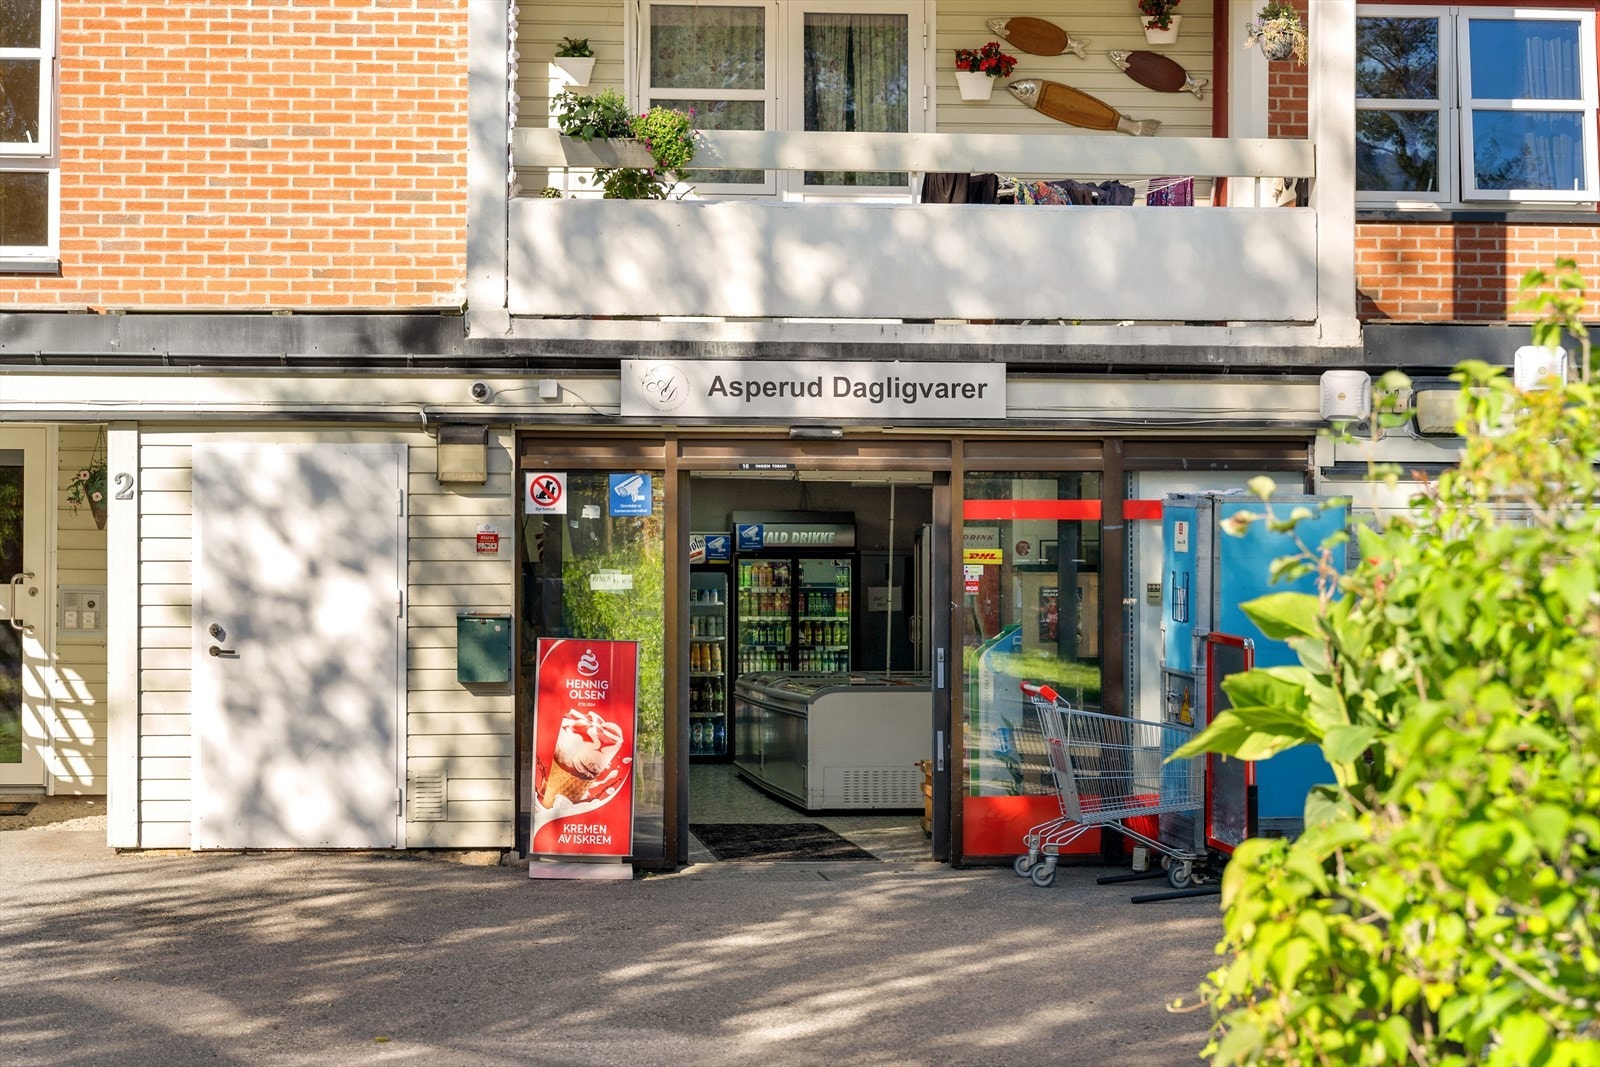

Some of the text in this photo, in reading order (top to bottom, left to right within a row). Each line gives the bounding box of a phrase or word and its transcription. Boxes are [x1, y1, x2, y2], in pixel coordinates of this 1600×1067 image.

[708, 375, 823, 402] Asperud
[833, 376, 988, 404] Dagligvarer
[114, 472, 135, 500] 2
[791, 531, 835, 544] DRIKKE
[968, 552, 997, 560] DHL
[565, 678, 609, 690] HENNIG
[568, 689, 606, 700] OLSEN
[563, 823, 607, 834] KREMEN
[557, 833, 612, 846] AV ISKREM
